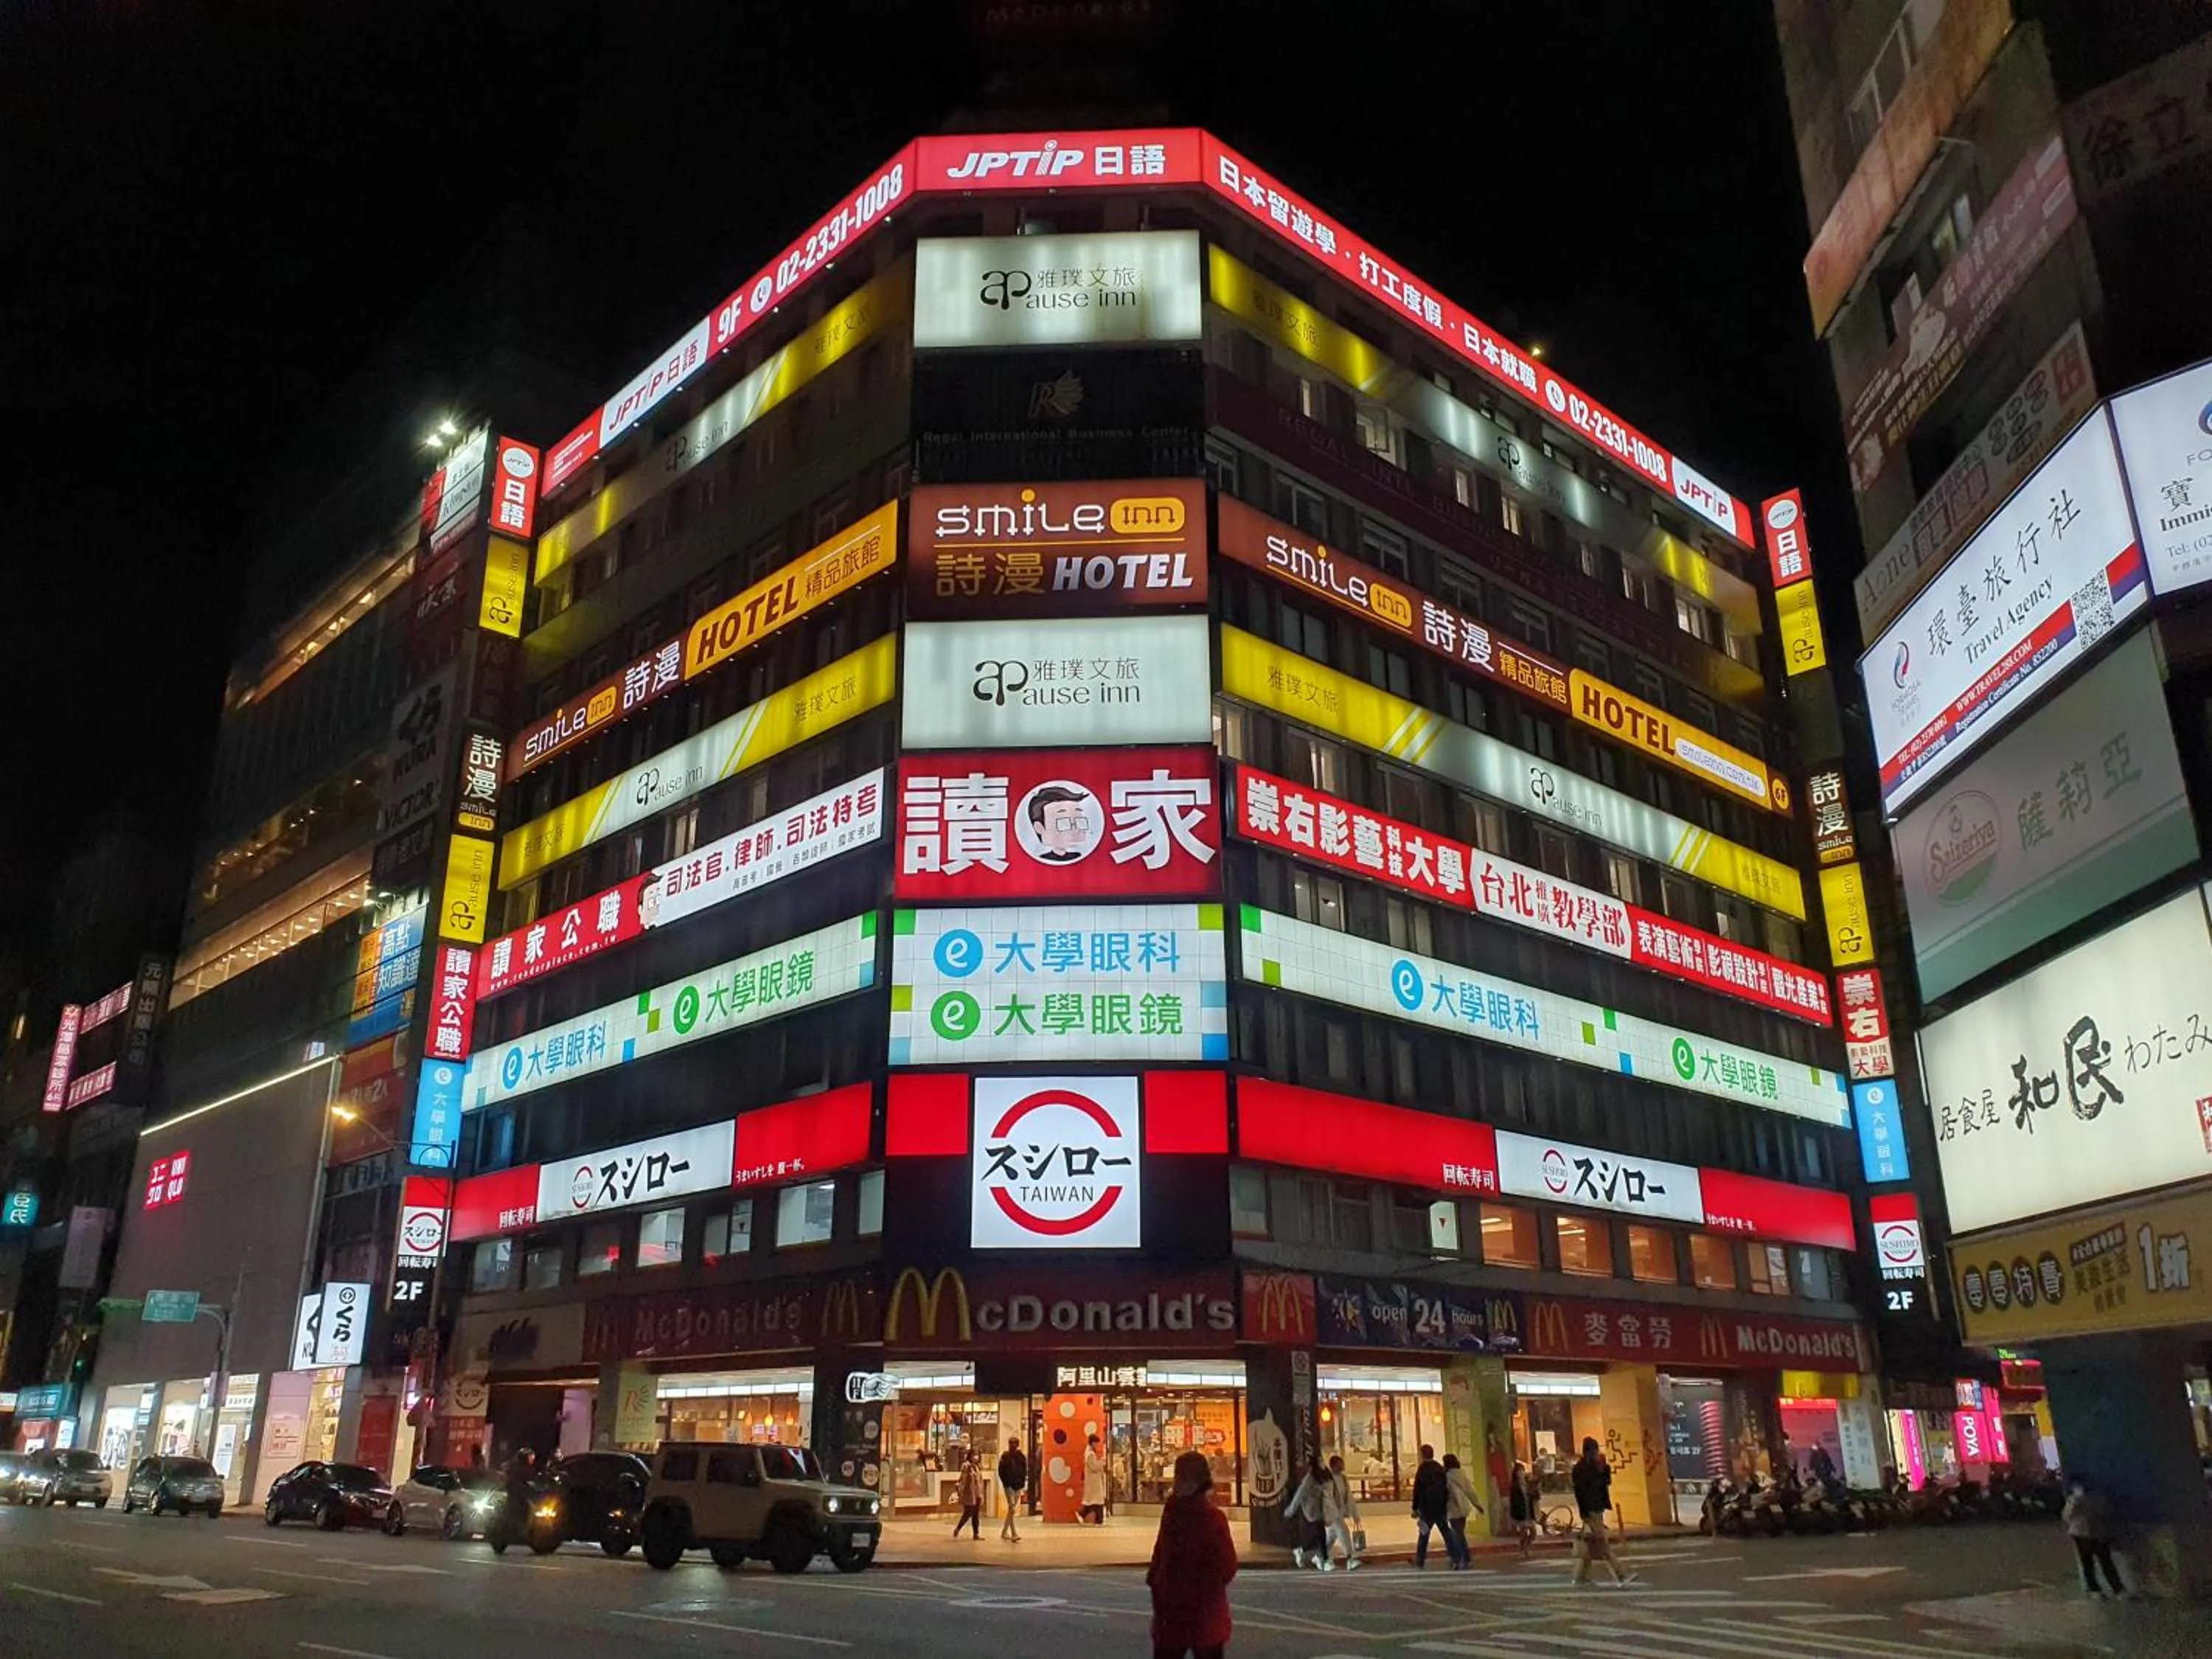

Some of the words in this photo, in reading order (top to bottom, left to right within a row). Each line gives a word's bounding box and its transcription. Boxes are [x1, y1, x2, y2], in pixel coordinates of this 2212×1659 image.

[1094, 145, 1165, 175] 日語
[717, 295, 742, 342] 9F
[776, 164, 903, 293] 02-2331-1008
[1098, 288, 1136, 307] inn
[1359, 252, 1442, 330] 打工度假
[1464, 323, 1537, 394] 日本就職
[668, 339, 699, 383] 日語
[1569, 394, 1666, 482] 02-2331-1008
[501, 479, 525, 529] 日語
[936, 552, 1045, 597] 詩漫
[1052, 553, 1194, 590] HOTEL
[1776, 529, 1803, 578] 日語
[1928, 488, 2080, 655] 環臺旅行社
[623, 640, 681, 709] 詩漫
[696, 576, 799, 664] HOTEL
[804, 535, 881, 599] 精品旅館
[1964, 624, 2005, 666] Travel
[2006, 574, 2053, 631] Agency
[1422, 600, 1495, 672] 詩漫
[1499, 650, 1567, 704] 精品旅館
[1100, 681, 1141, 703] inn
[1582, 684, 1675, 757] HOTEL
[464, 734, 501, 802] 詩漫
[686, 766, 703, 787] inn
[1811, 772, 1848, 837] 詩漫
[1248, 777, 1465, 894] 崇右影藝科技大學
[490, 889, 620, 979] 讀家公職
[995, 931, 1181, 974] 大學眼科
[435, 948, 472, 1053] 讀家公職
[706, 950, 813, 1023] 大學眼鏡
[1430, 975, 1540, 1040] 大學眼科
[1843, 973, 1881, 1038] 崇右
[994, 992, 1183, 1036] 大學眼鏡
[526, 1020, 607, 1082] 大學眼科
[1700, 1048, 1779, 1101] 大學眼鏡
[1854, 1055, 1890, 1077] 大學
[2008, 1015, 2125, 1135] 和民
[2124, 1013, 2212, 1074] わたみ
[981, 1143, 1132, 1181] スシロー
[1872, 1111, 1895, 1178] 大學眼科
[499, 1206, 535, 1229] 回転寿司
[596, 1150, 689, 1205] スシロー
[1020, 1186, 1094, 1203] TAIWAN
[1443, 1163, 1495, 1191] 回転寿司
[1574, 1156, 1666, 1204] スシロー
[393, 1281, 424, 1301] 2F
[887, 1267, 1236, 1342] McDonald's
[1372, 1304, 1408, 1324] open
[1415, 1298, 1446, 1335] 24
[1452, 1307, 1484, 1327] hours
[1887, 1291, 1913, 1310] 2F
[333, 1305, 355, 1342] くら
[1585, 1312, 1672, 1349] 麥當勞
[1737, 1325, 1856, 1360] McDonald's
[1961, 1416, 1980, 1457] POYA
